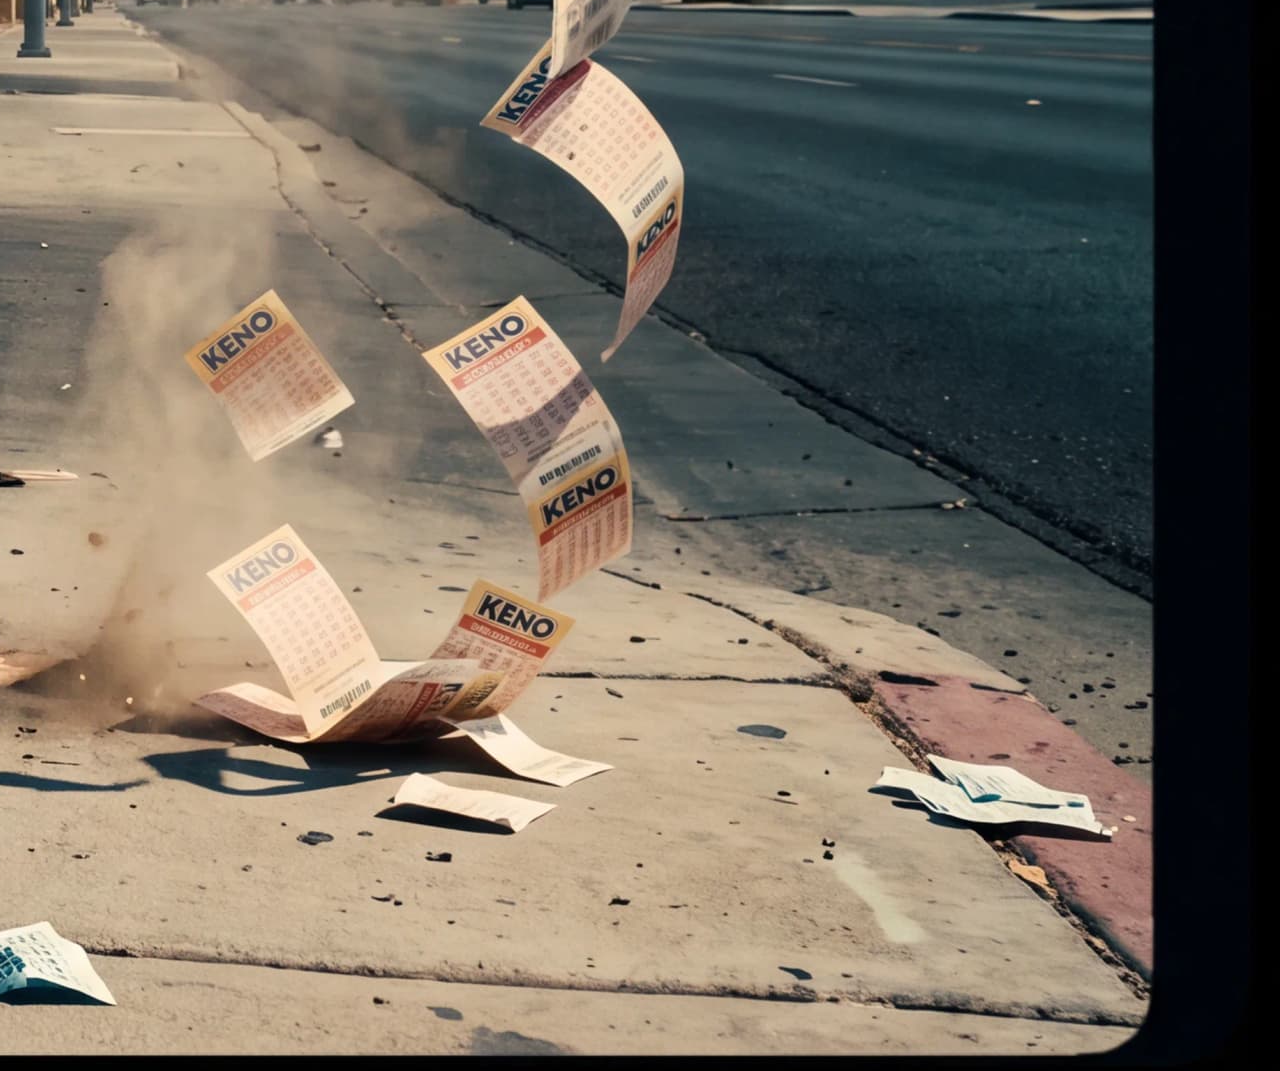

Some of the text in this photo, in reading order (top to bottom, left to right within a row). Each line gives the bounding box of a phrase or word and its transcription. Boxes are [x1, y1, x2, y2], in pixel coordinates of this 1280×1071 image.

[201, 311, 274, 371] KENO
[444, 314, 525, 370] KENO
[542, 468, 616, 526] KENO
[226, 541, 295, 593] KENO
[476, 594, 555, 639] KENO
